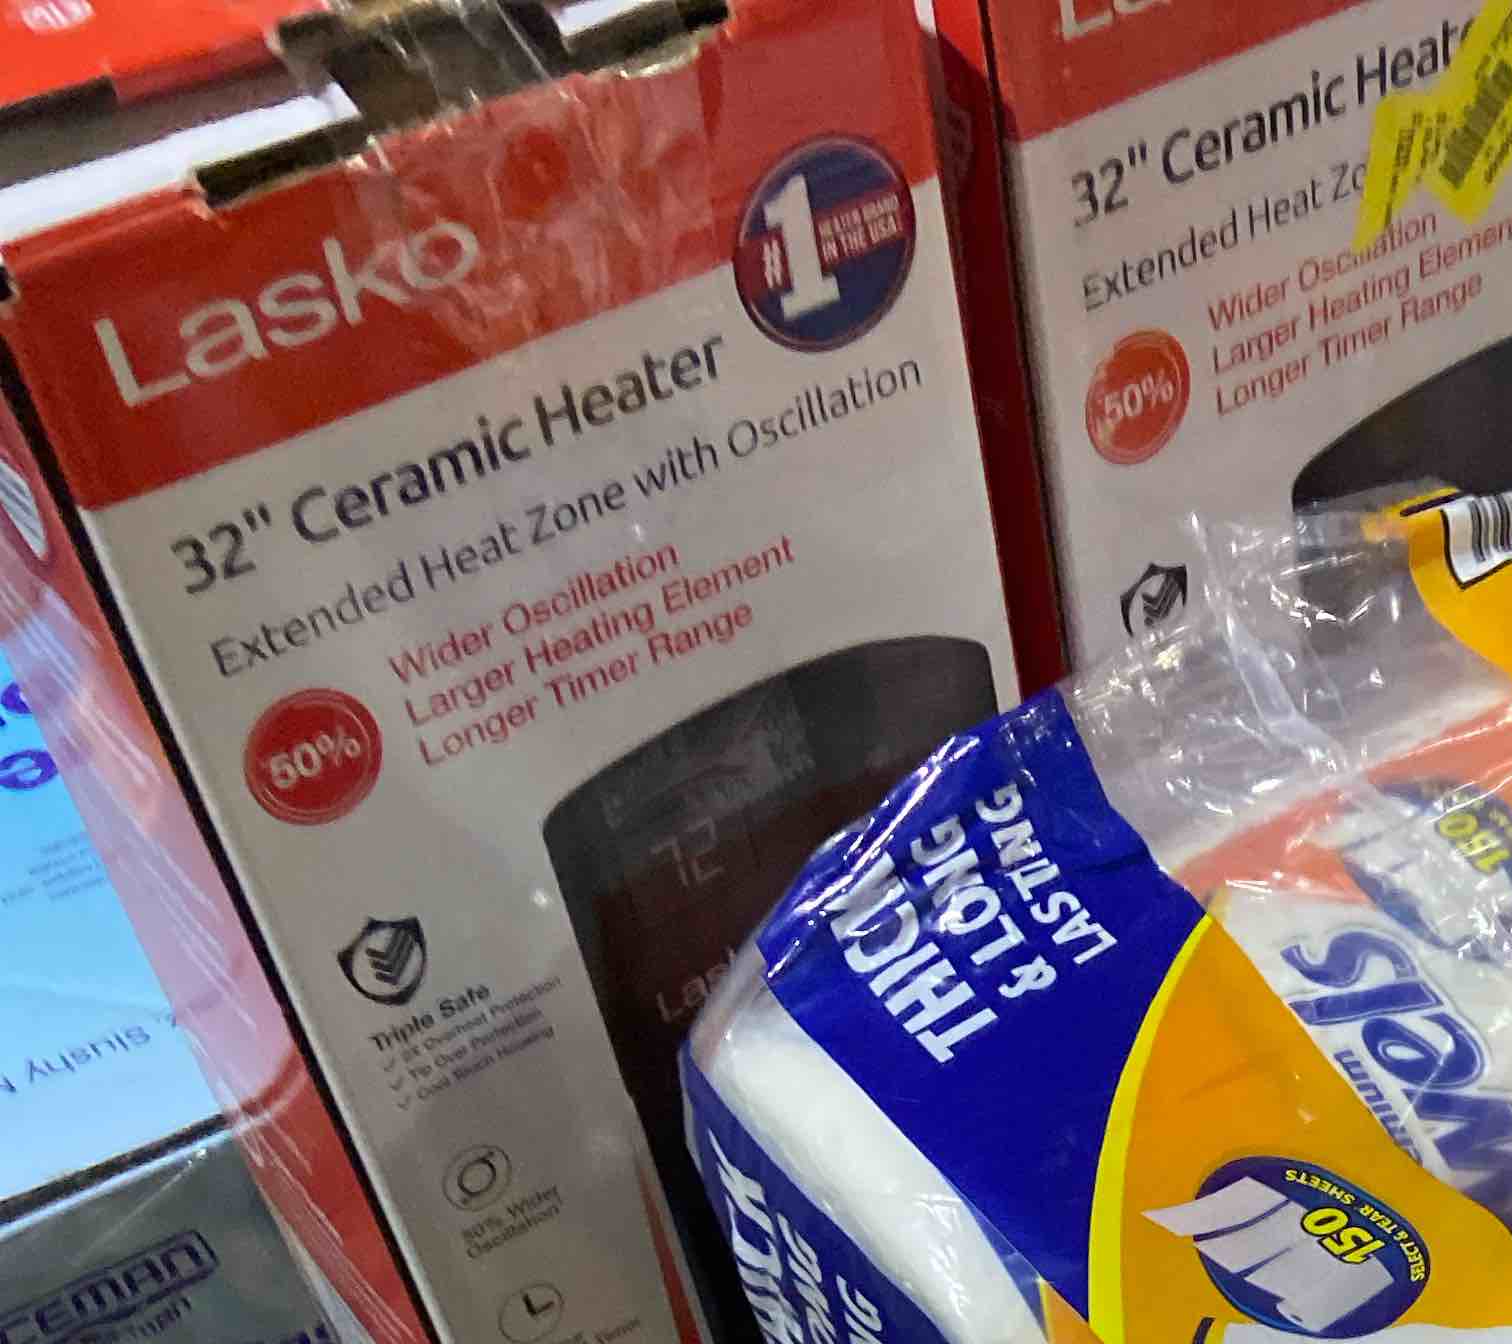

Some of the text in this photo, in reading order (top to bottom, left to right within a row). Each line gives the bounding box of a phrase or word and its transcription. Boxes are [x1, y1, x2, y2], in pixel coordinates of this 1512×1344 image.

[1073, 142, 1150, 228] 32"
[1162, 70, 1345, 186] Ceramic
[93, 215, 480, 408] Lasko
[1082, 181, 1321, 311] Extended Heat
[1207, 274, 1291, 333] Wider
[1211, 320, 1300, 375] Larger
[1308, 265, 1411, 331] Heating
[1214, 272, 1485, 417] Longer Timer Range
[168, 330, 728, 595] 32" Ceramic Heater
[1101, 374, 1177, 428] 50%
[209, 354, 924, 680] Extended Heat Zone with Oscillation
[386, 540, 681, 688] Wider Oscillation
[404, 535, 797, 727] Larger Heating Element
[417, 603, 756, 767] Longer Timer Range
[265, 724, 362, 788] 50%
[910, 814, 1058, 1000] & LONG
[976, 782, 1119, 966] LASTING
[369, 983, 491, 1053] Triple Safe
[824, 852, 998, 1064] THICK
[24, 1024, 153, 1085] Slushy
[1283, 1168, 1358, 1212] SHEETS
[1300, 1205, 1386, 1264] 150
[1358, 1202, 1403, 1246] TEAR
